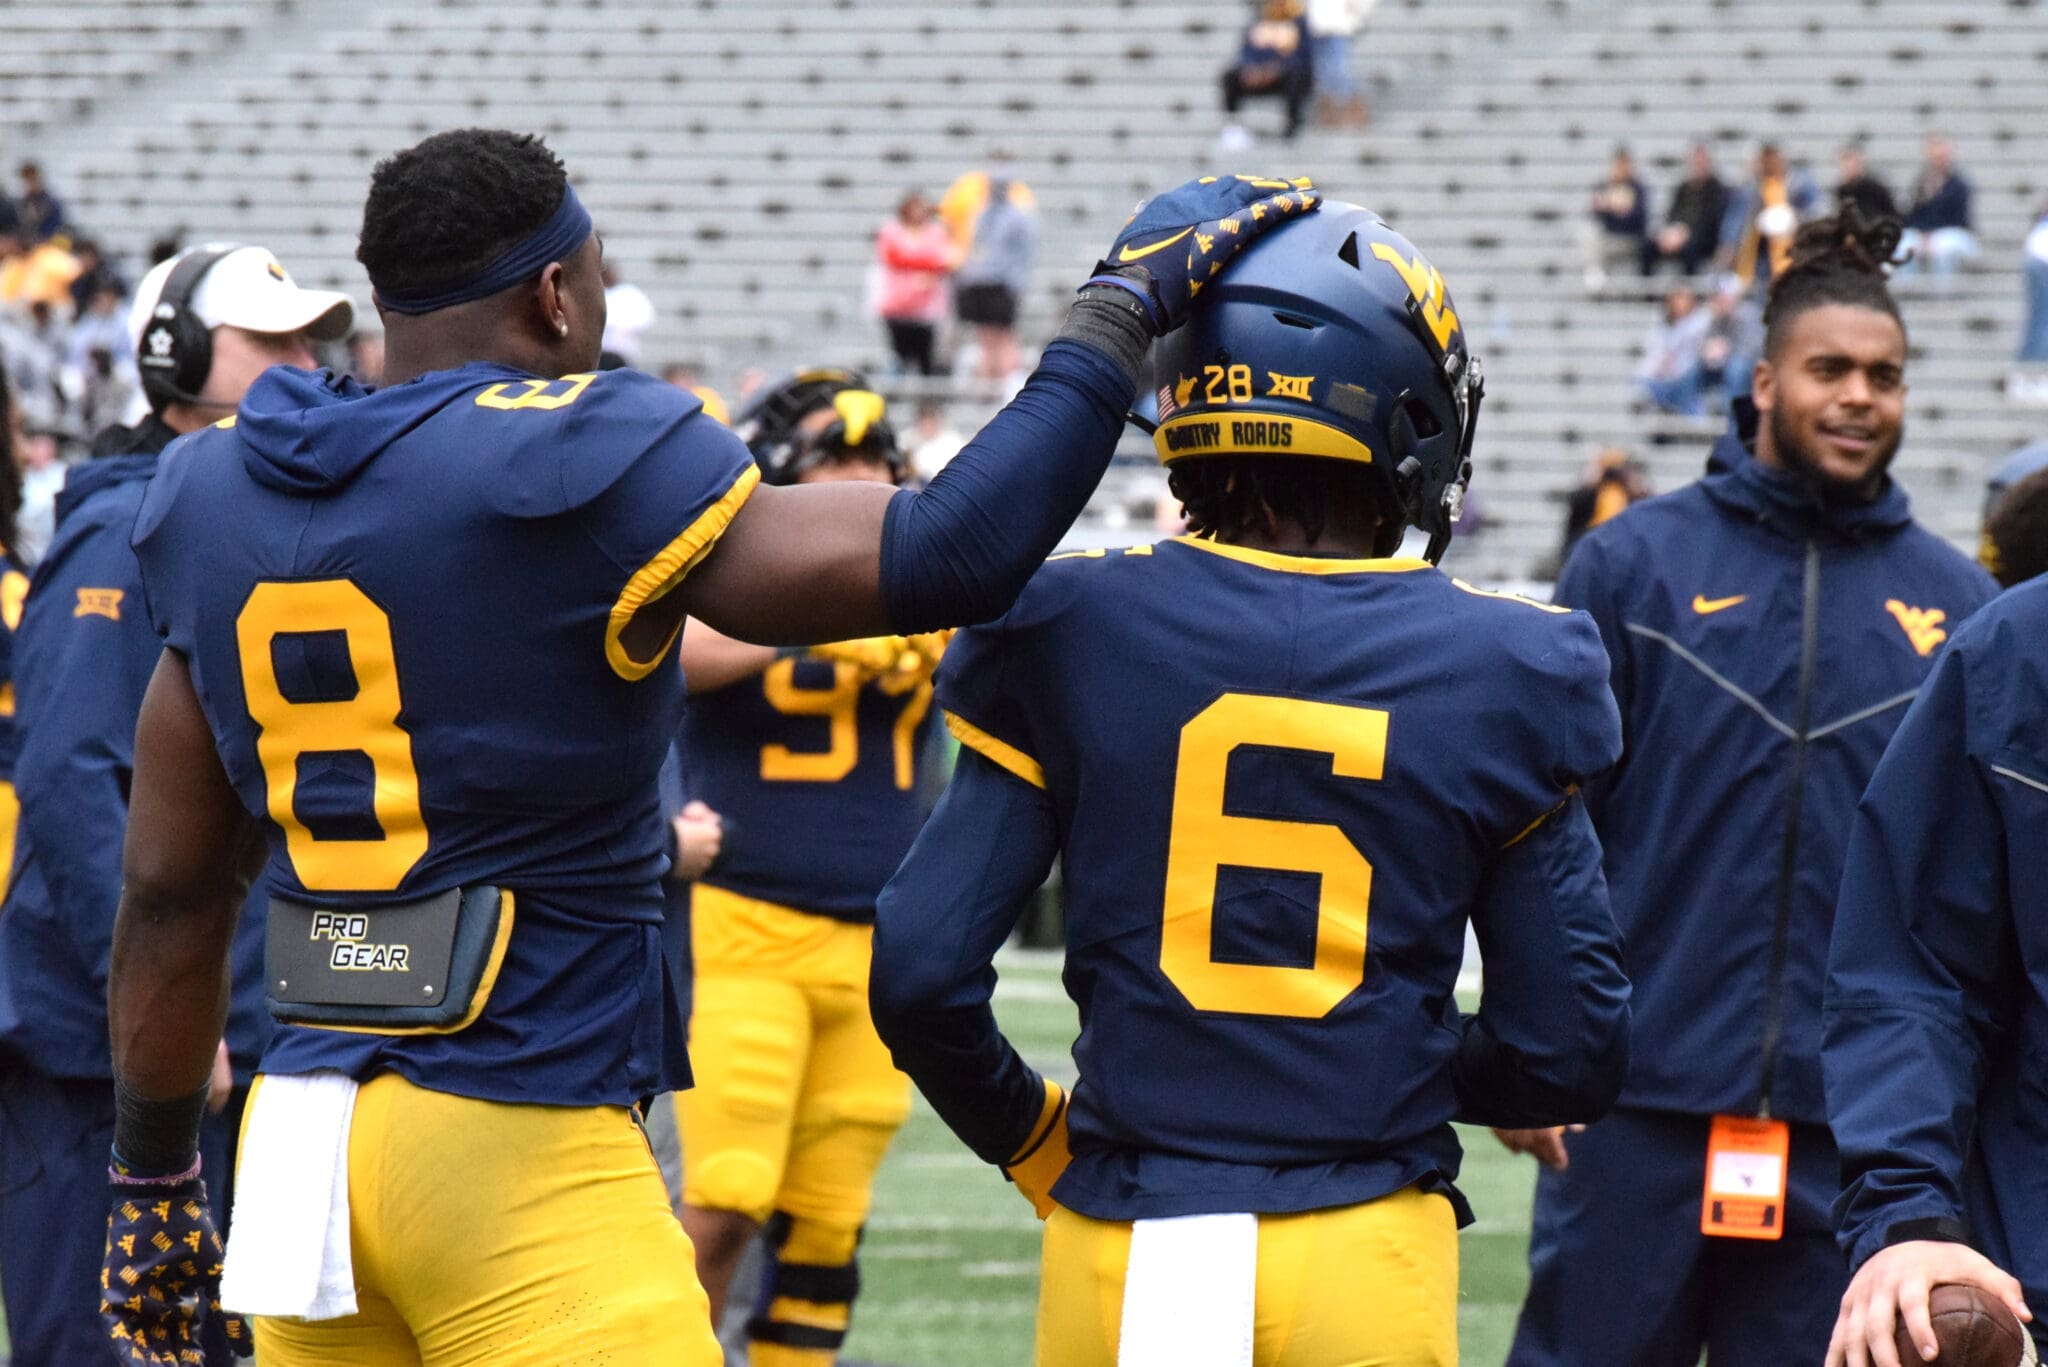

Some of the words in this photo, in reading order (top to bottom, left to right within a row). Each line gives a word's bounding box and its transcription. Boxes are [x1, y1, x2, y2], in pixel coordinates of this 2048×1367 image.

[1204, 364, 1253, 404] 28
[1266, 371, 1315, 402] XII
[1231, 421, 1293, 447] ROADS
[236, 578, 429, 891] 8
[1159, 692, 1389, 1019] 6
[310, 910, 369, 941] PRO
[329, 939, 410, 972] GEAR
